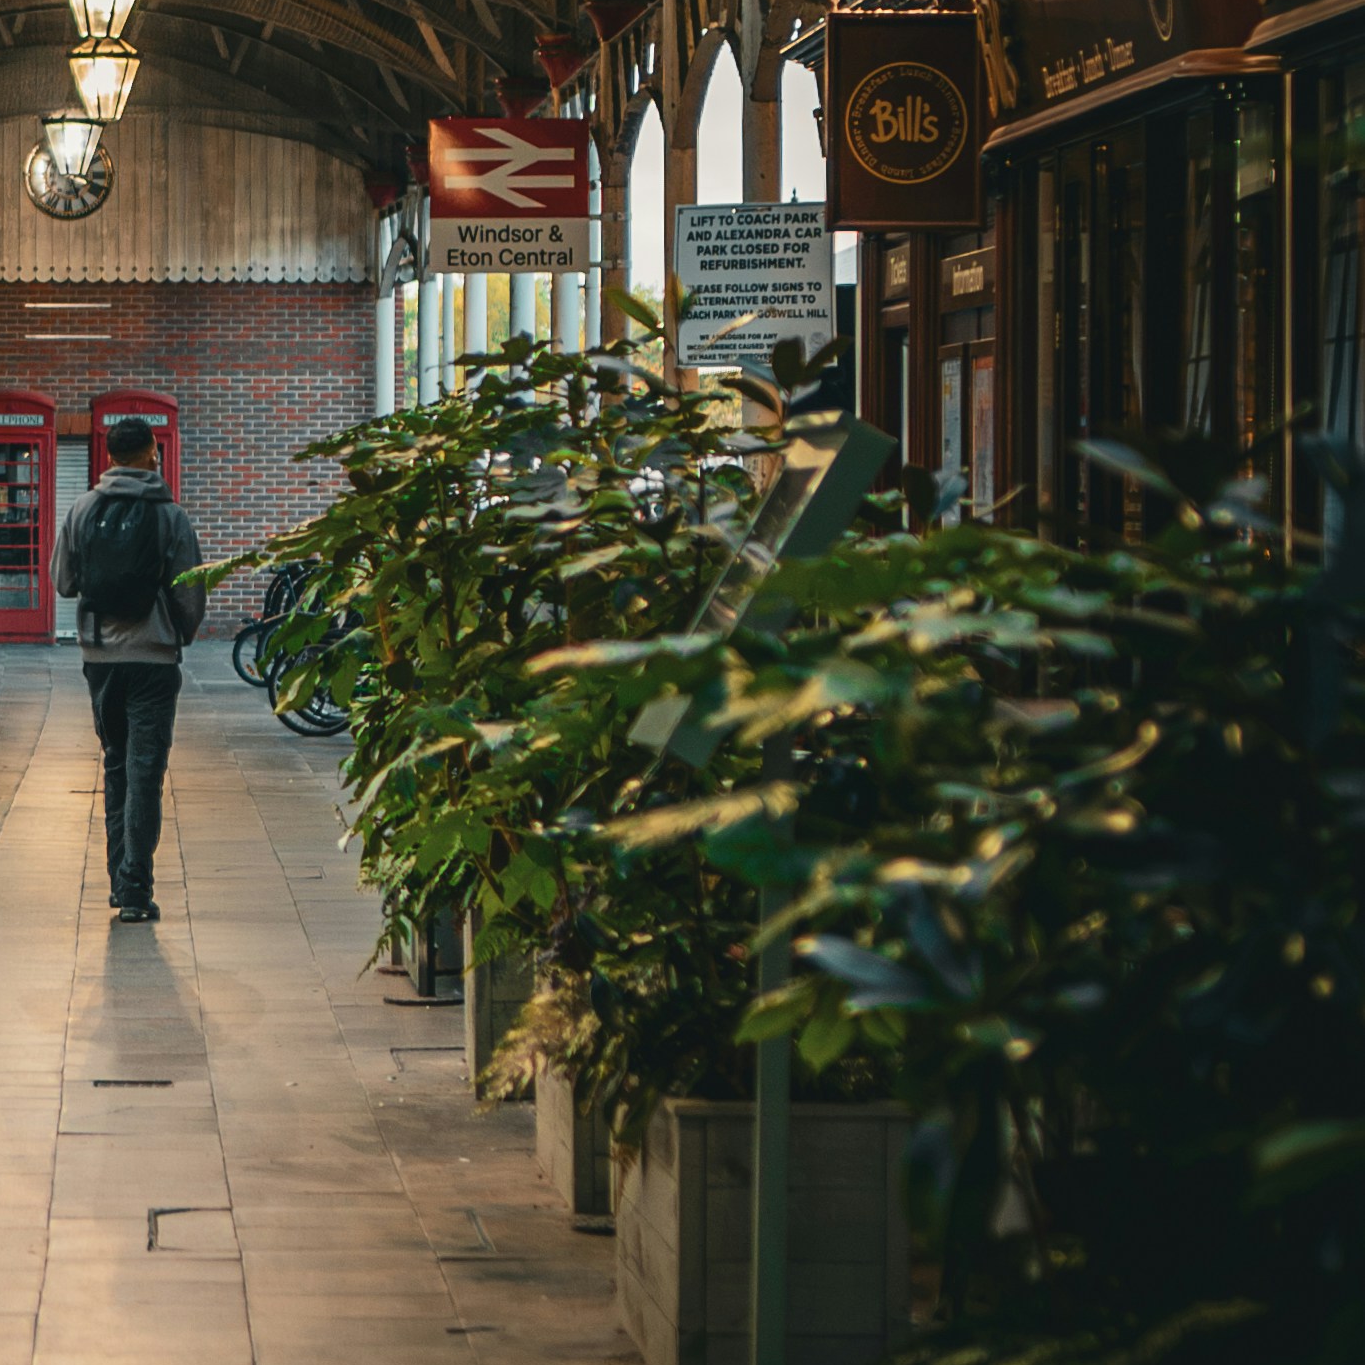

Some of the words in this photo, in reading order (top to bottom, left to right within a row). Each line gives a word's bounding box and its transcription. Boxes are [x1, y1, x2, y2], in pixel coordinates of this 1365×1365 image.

[869, 95, 939, 143] Bill's
[690, 216, 715, 227] LIFT
[719, 215, 733, 226] TO
[737, 214, 780, 225] COACH
[784, 212, 818, 224] PARK
[458, 224, 543, 243] Windsor
[549, 224, 563, 243] &
[687, 231, 712, 242] AND
[715, 228, 791, 241] ALEXANDRA
[795, 227, 822, 239] CAR
[447, 248, 493, 266] Eton
[499, 247, 573, 266] Central
[696, 244, 727, 256] PARK
[731, 243, 779, 255] CLOSED
[784, 242, 810, 254] FOR
[700, 257, 806, 271] REFURBISHMENT.
[952, 260, 984, 297] Information
[689, 284, 722, 294] LEASE
[725, 283, 769, 293] FOLLOW
[771, 282, 804, 292] SIGNS
[807, 282, 822, 292] TO
[762, 295, 798, 305] ROUTE
[801, 294, 816, 304] TO
[713, 310, 736, 319] PARK
[757, 308, 804, 319] GOSWELL
[807, 308, 828, 318] HILL
